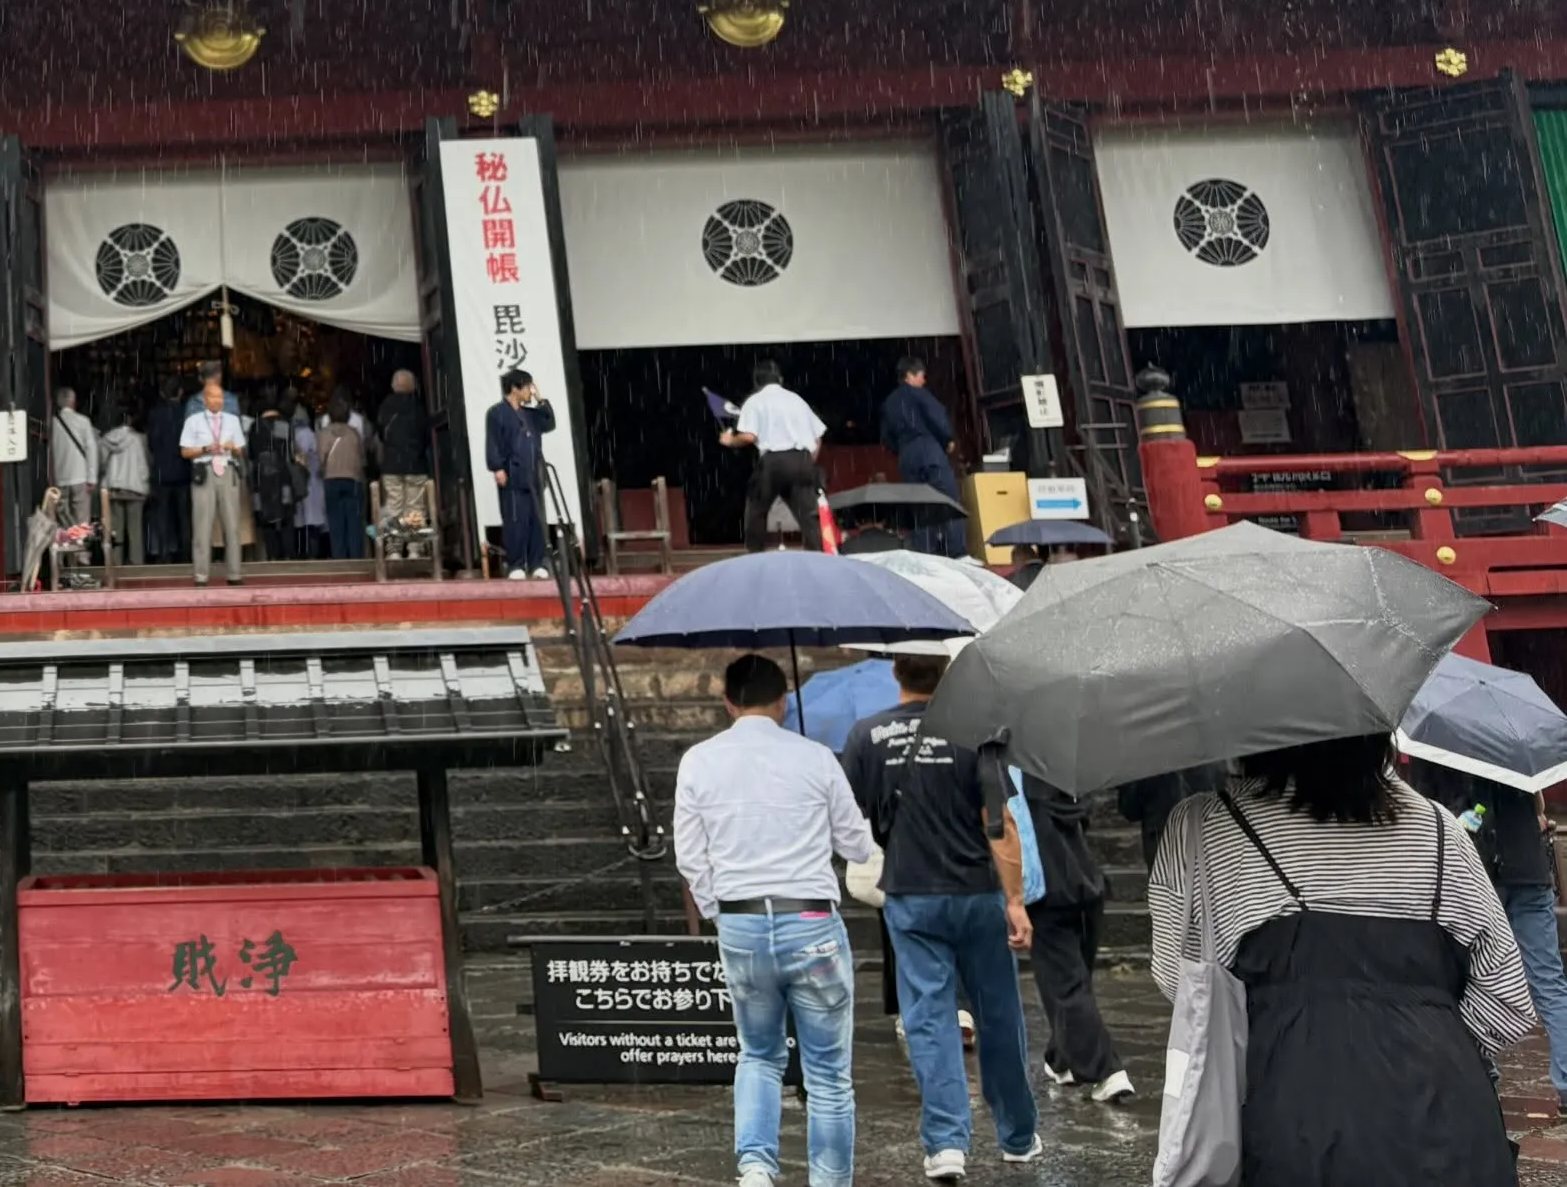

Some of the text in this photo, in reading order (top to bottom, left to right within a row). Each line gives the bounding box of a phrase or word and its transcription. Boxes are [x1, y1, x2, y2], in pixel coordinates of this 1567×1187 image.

[473, 150, 528, 371] 秘仏開帳 毘沙
[546, 959, 729, 984] 拝観券をお持ちでな
[575, 987, 734, 1012] こちらでお参り下
[558, 1032, 607, 1047] Visitors
[609, 1032, 663, 1047] without
[665, 1036, 674, 1047] a
[676, 1032, 714, 1047] ticket
[715, 1036, 737, 1047] are
[620, 1049, 738, 1066] offer prayers here
